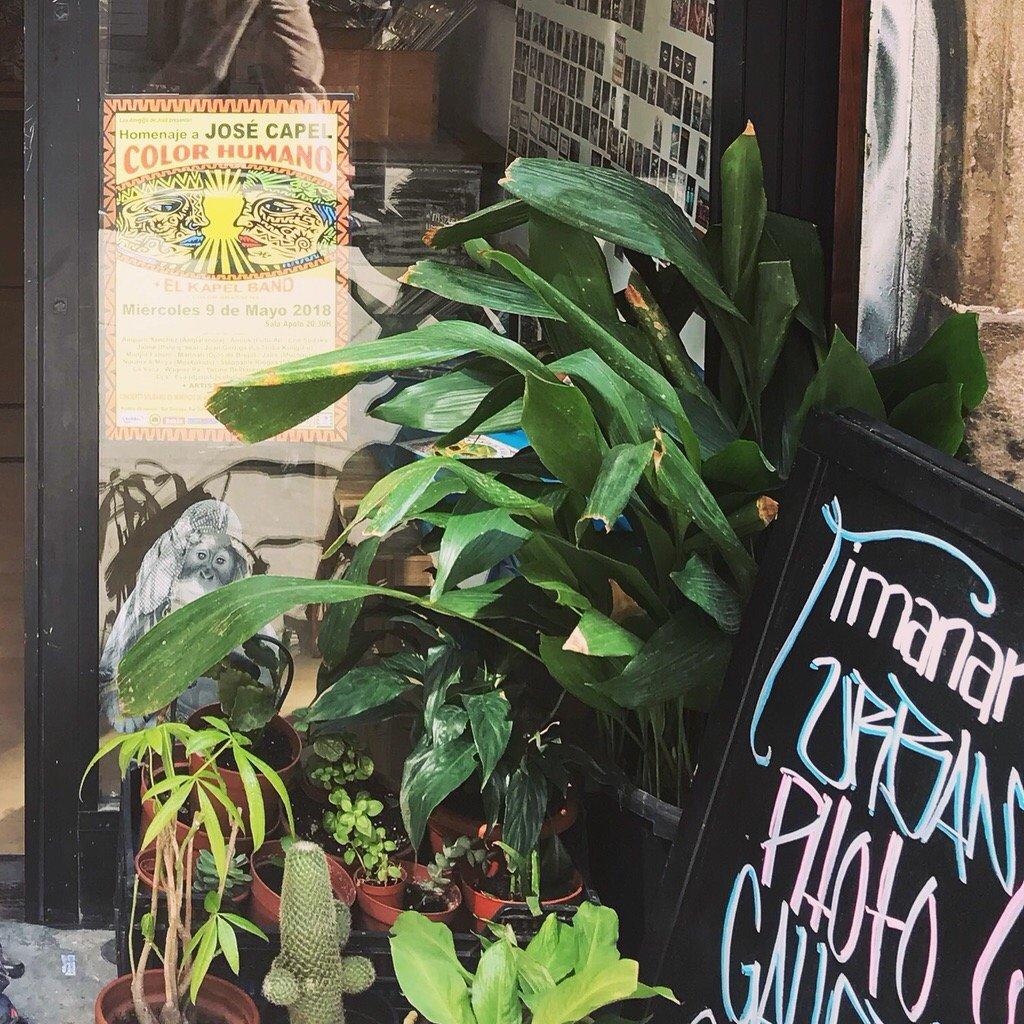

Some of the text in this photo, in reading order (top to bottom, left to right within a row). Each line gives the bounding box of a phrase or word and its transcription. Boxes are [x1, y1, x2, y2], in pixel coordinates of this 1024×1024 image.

[119, 129, 188, 142] Homenaje
[191, 131, 200, 140] a
[205, 119, 259, 140] JOSÉ
[265, 122, 333, 140] CAPEL
[123, 143, 333, 175] COLOR HUMANO
[164, 278, 184, 293] EL
[206, 304, 216, 317] 9
[221, 303, 241, 317] de
[246, 304, 288, 320] Mayo
[293, 303, 333, 317] 2018
[761, 766, 939, 1022] PHOTO
